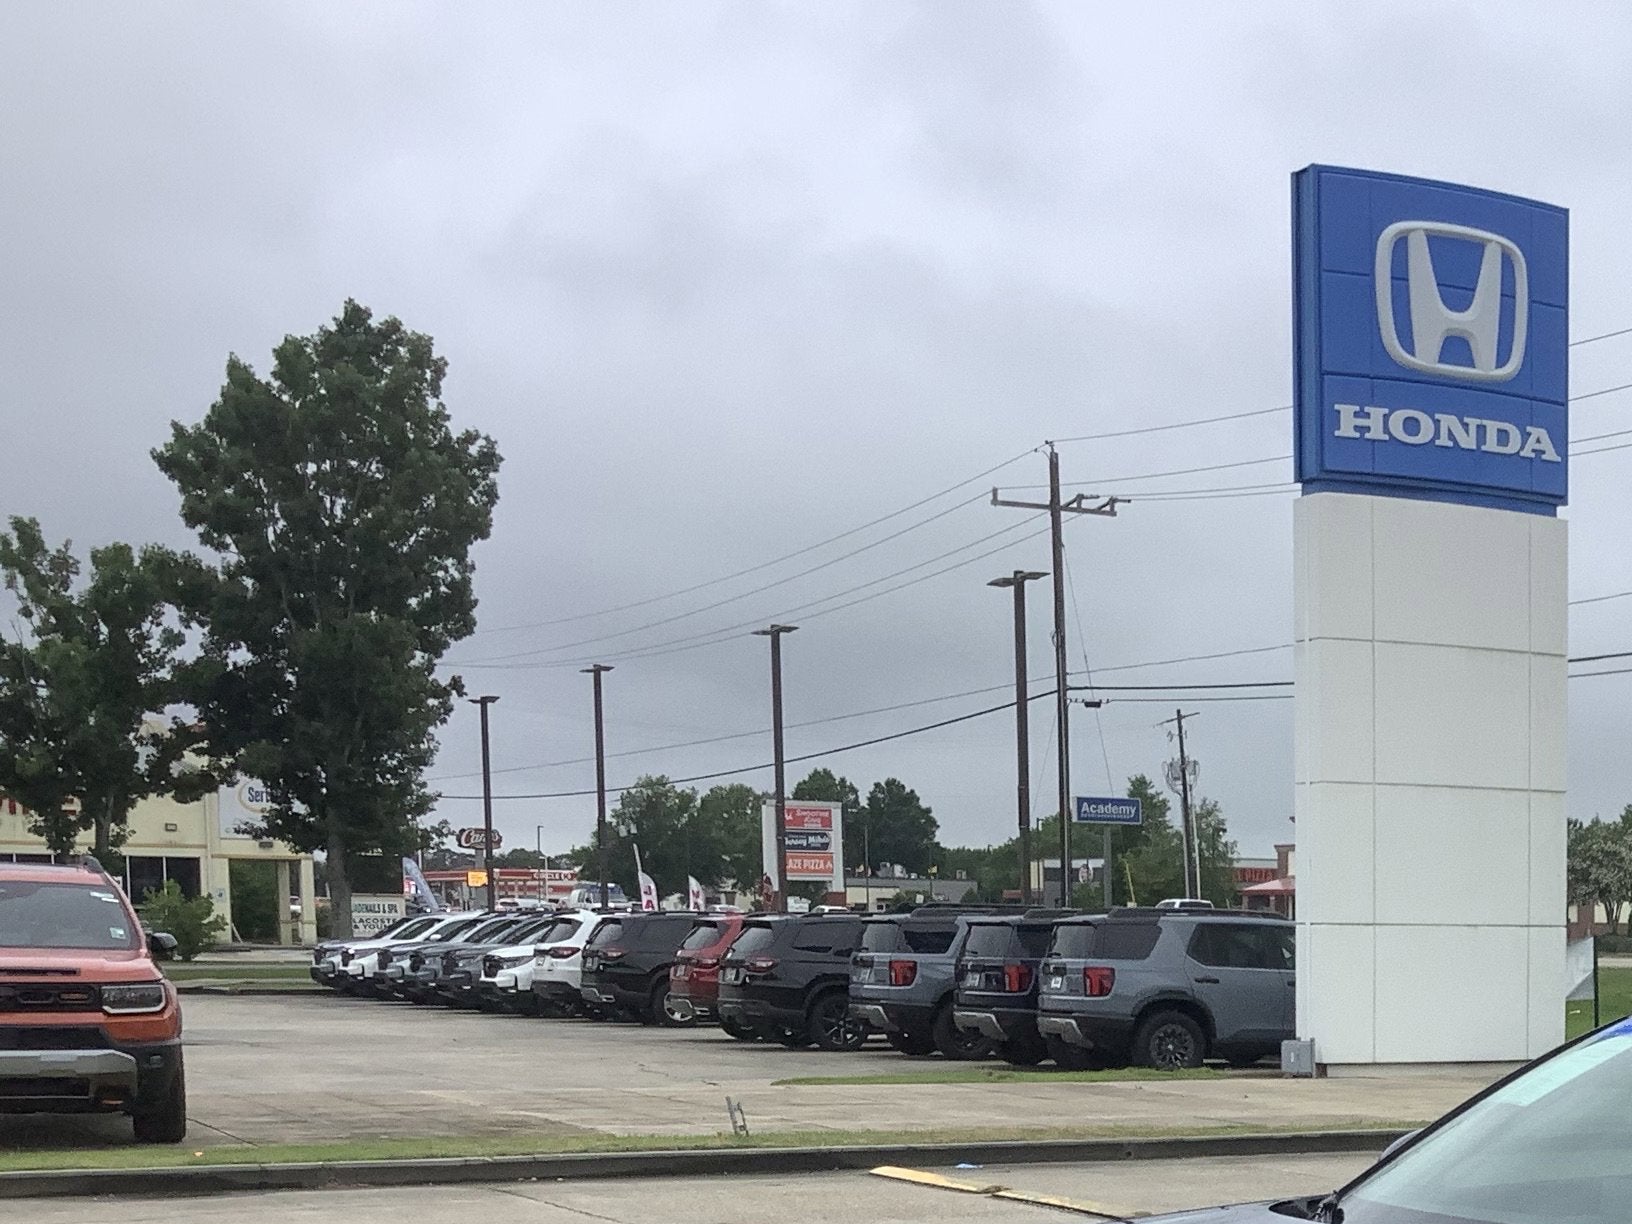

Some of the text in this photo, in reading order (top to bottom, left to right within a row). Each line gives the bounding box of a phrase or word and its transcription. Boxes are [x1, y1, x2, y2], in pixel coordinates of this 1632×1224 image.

[1334, 404, 1562, 463] HONDA
[1081, 802, 1136, 818] Academy
[803, 859, 824, 870] PIZZA
